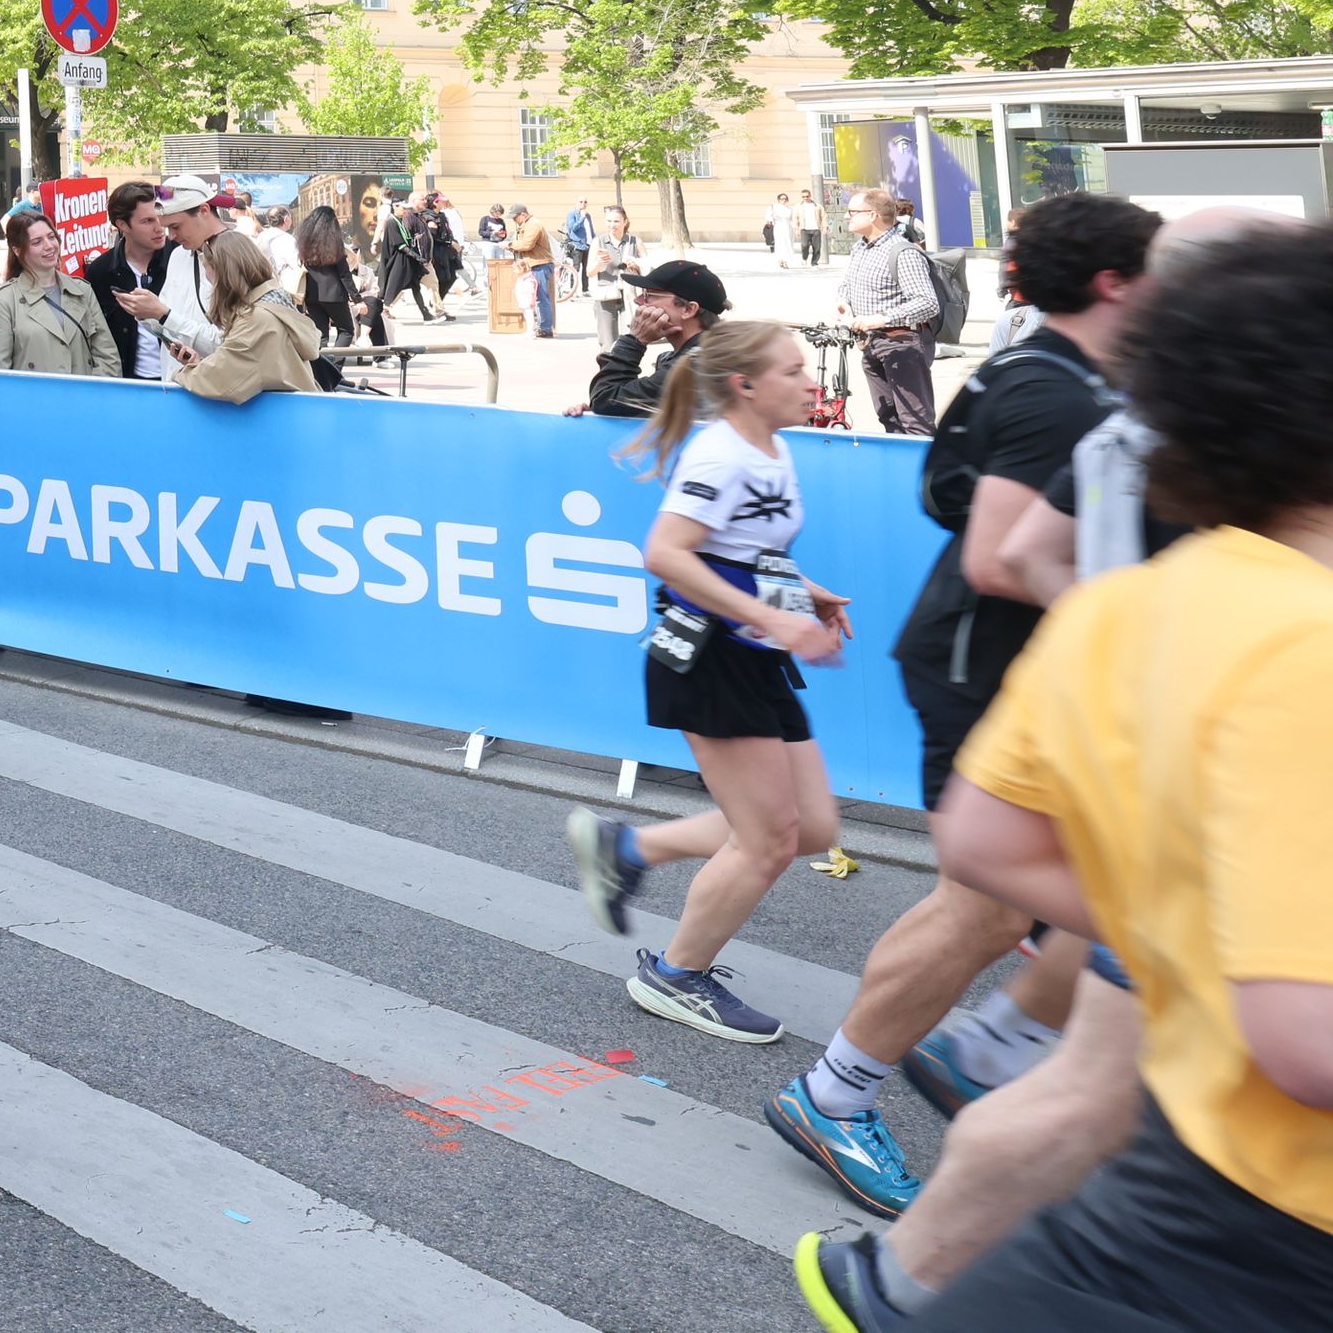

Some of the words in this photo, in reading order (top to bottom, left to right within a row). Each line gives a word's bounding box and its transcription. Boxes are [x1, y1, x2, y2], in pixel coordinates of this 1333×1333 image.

[64, 61, 102, 83] Anfang
[82, 144, 101, 154] MQ
[55, 189, 107, 224] Kronen
[57, 221, 111, 257] Zeitung
